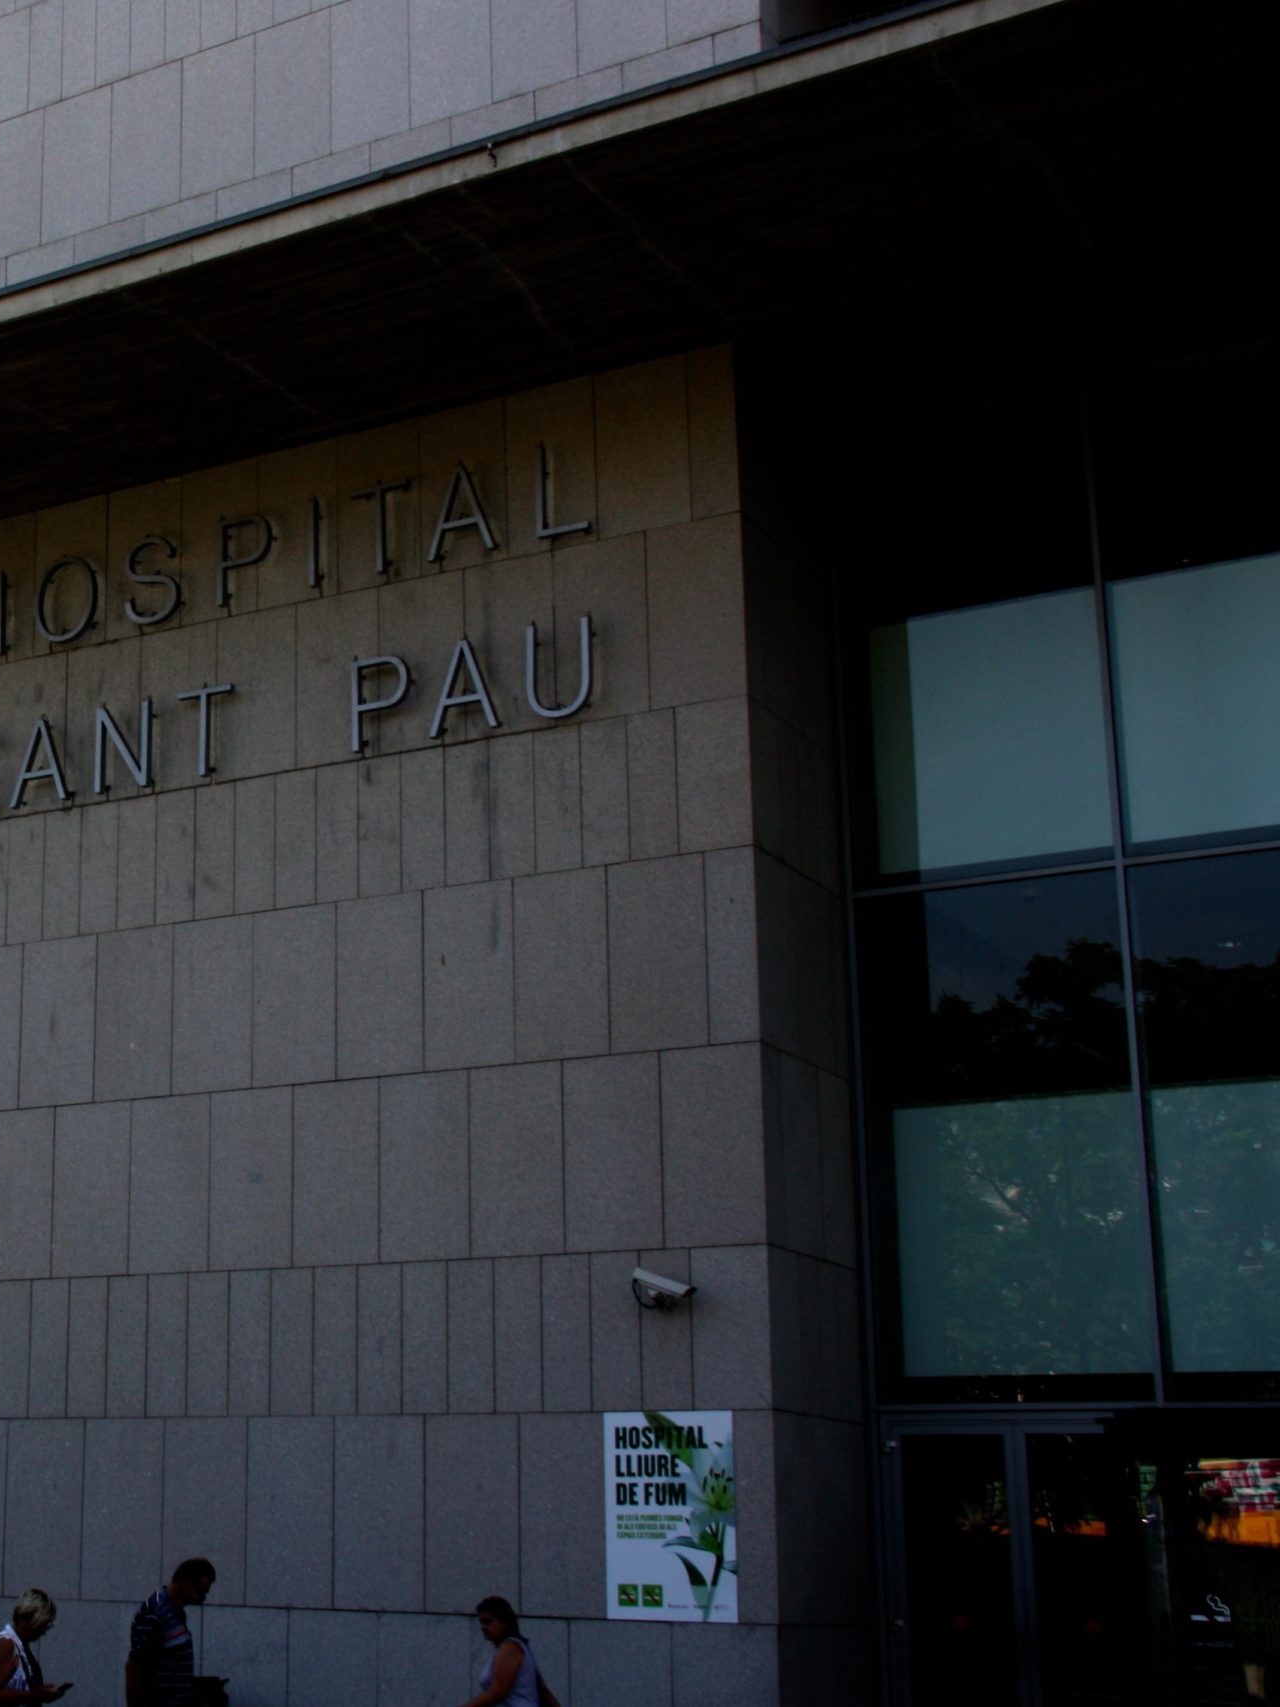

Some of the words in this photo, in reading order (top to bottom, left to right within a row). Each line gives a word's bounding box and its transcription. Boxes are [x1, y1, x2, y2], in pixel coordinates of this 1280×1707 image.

[351, 613, 595, 753] PAU
[615, 1426, 707, 1449] HOSPITAL
[616, 1455, 680, 1477] LLIURE
[616, 1483, 638, 1505] DE
[644, 1483, 686, 1505] FUM
